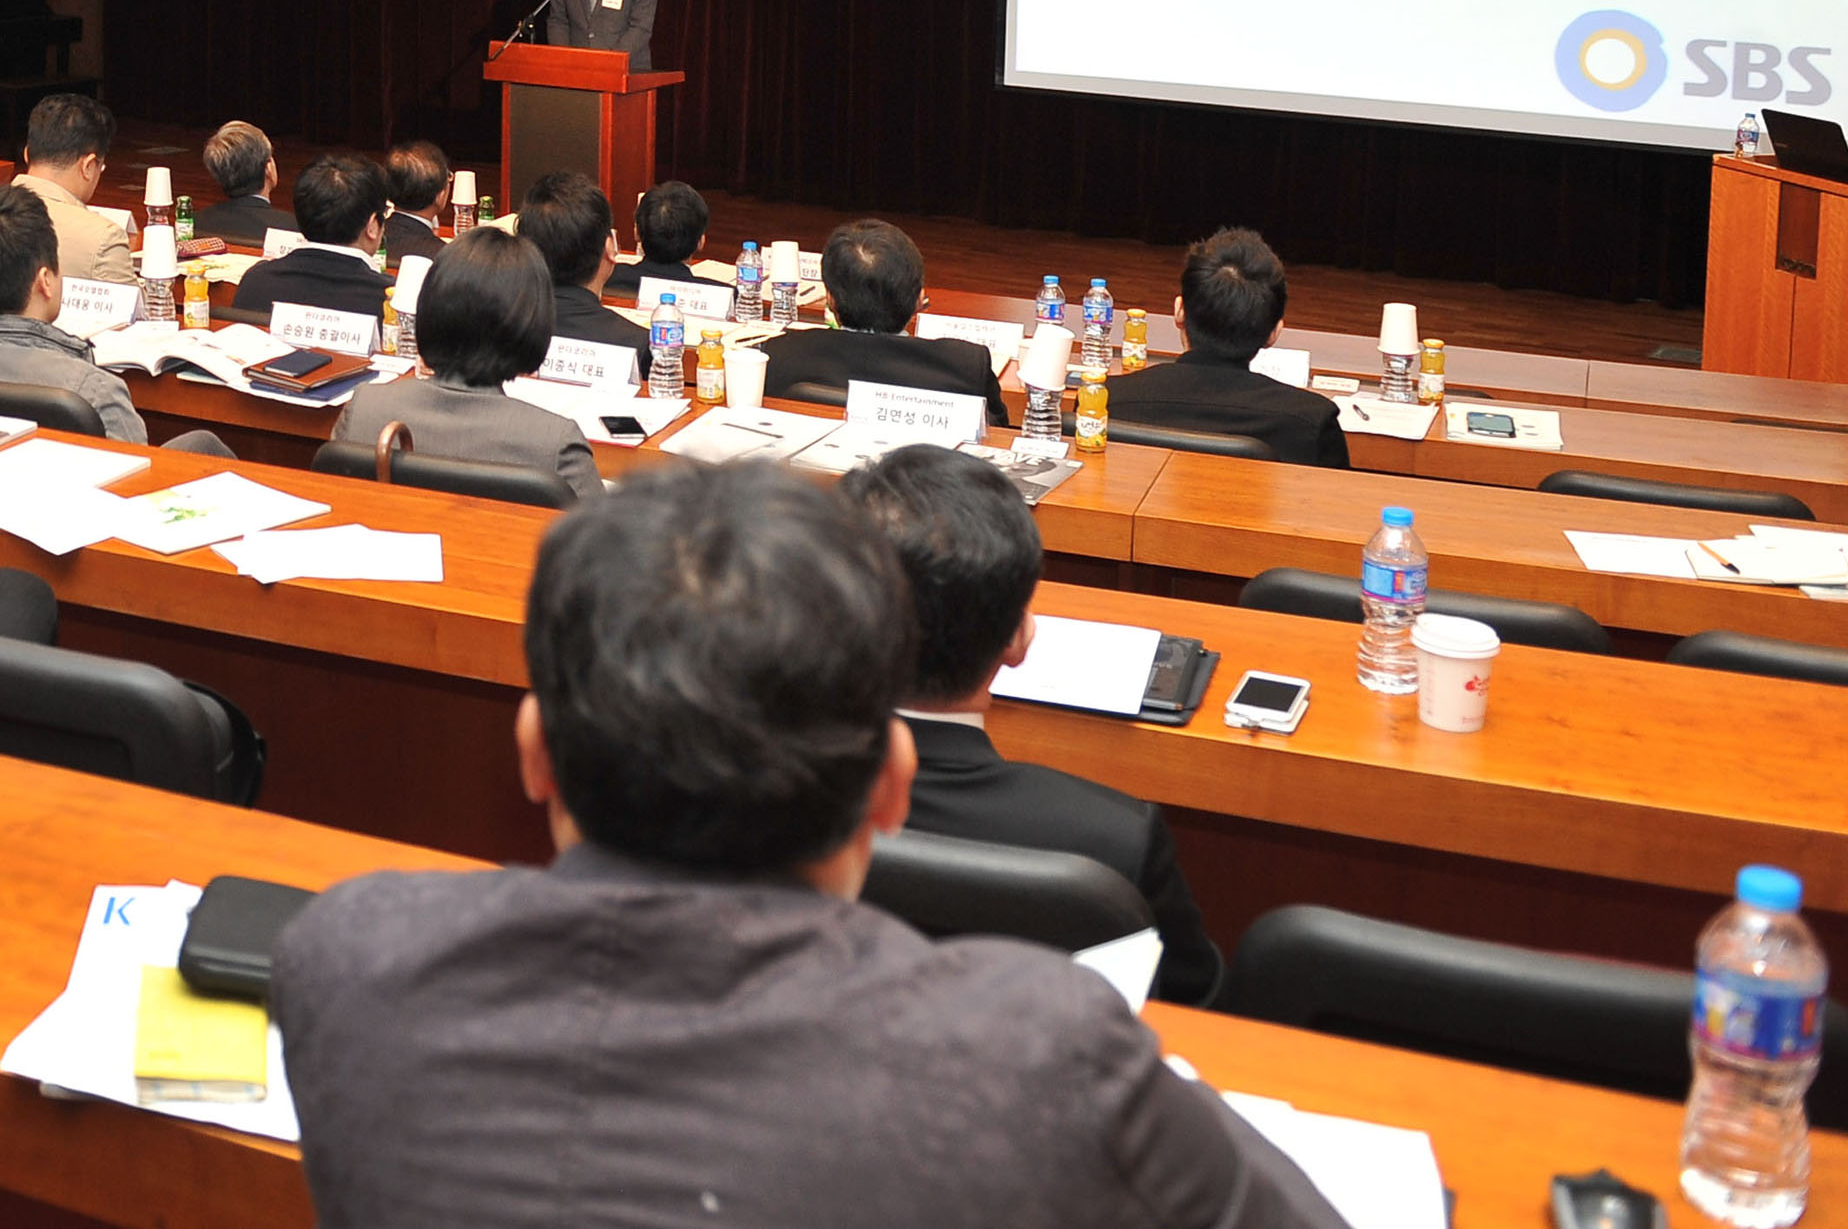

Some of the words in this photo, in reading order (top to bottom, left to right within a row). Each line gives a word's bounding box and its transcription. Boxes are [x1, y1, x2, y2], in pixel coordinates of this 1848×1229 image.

[1683, 38, 1832, 107] SBS
[94, 301, 113, 313] 이사
[582, 364, 605, 378] 대표
[922, 413, 949, 430] 이사
